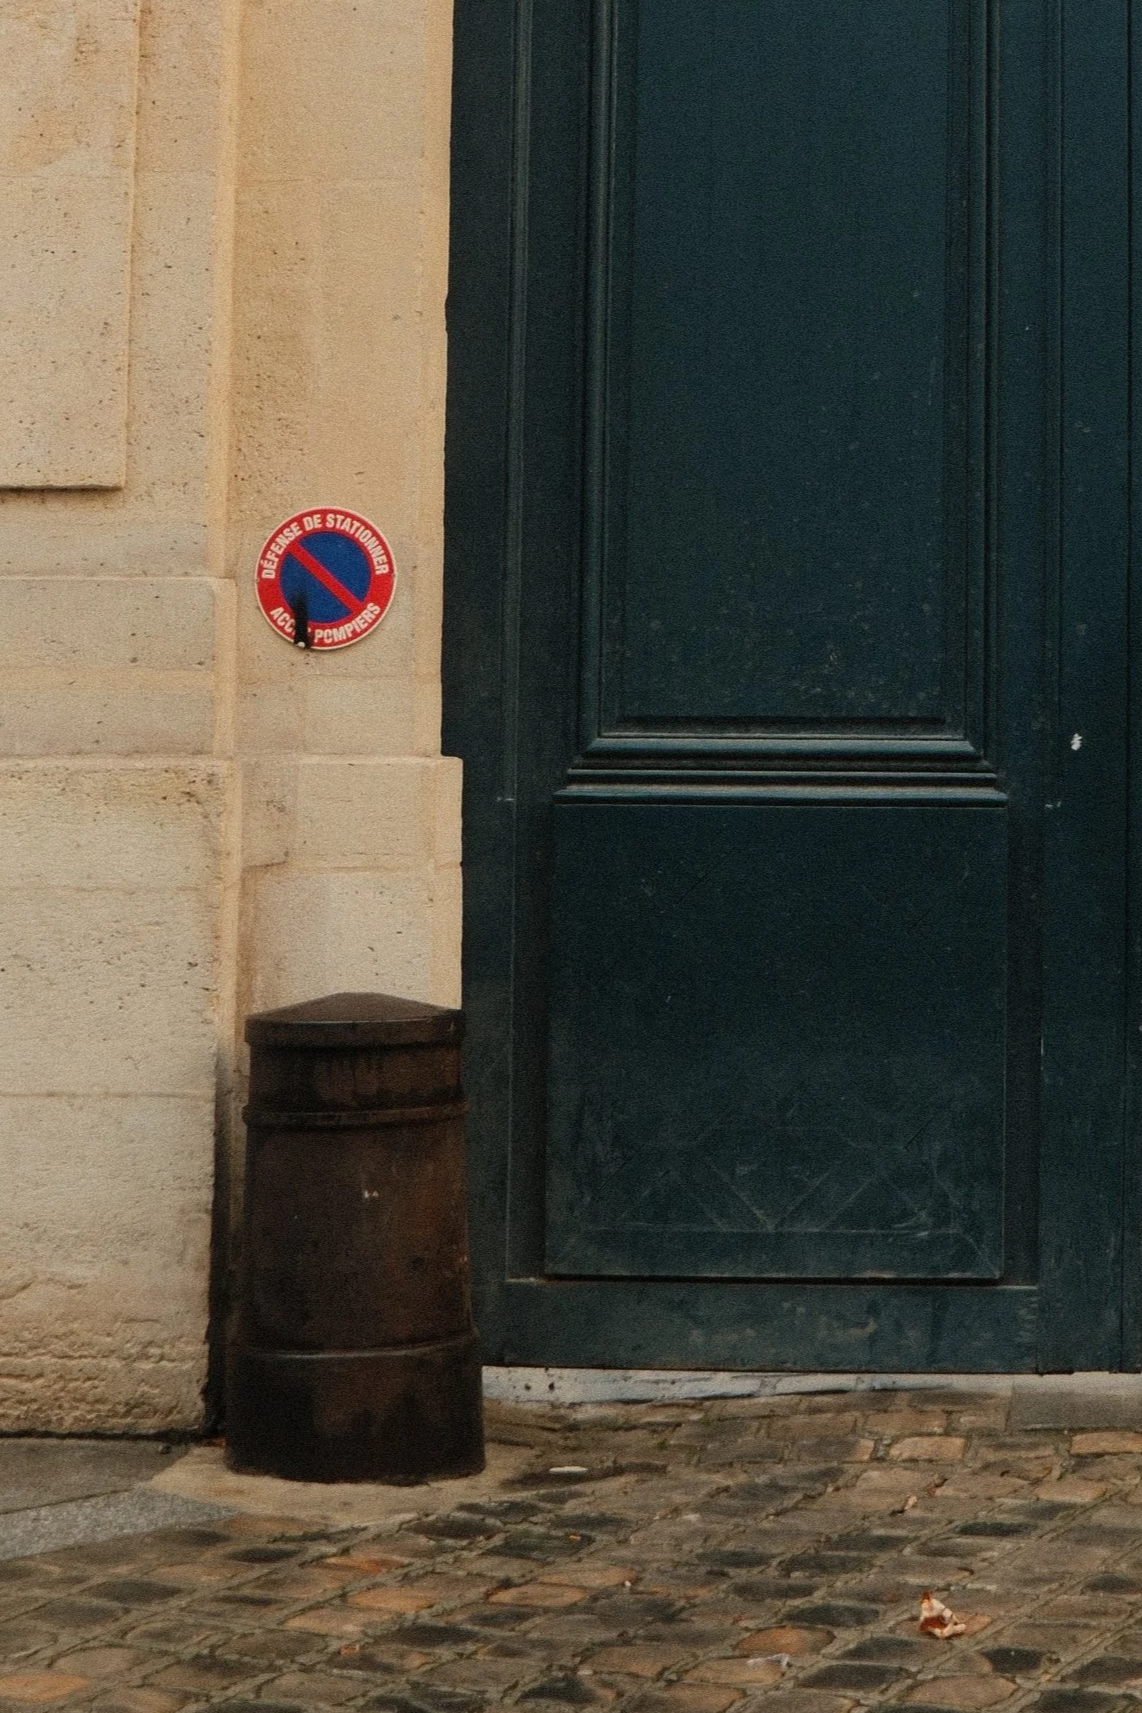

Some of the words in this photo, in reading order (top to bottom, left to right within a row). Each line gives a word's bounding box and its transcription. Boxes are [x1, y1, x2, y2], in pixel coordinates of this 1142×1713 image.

[260, 522, 303, 579] DÉFENSE
[302, 514, 323, 531] DE
[325, 513, 389, 575] STATIONNER
[269, 606, 311, 636] ACC
[314, 602, 382, 643] POMPIERS
